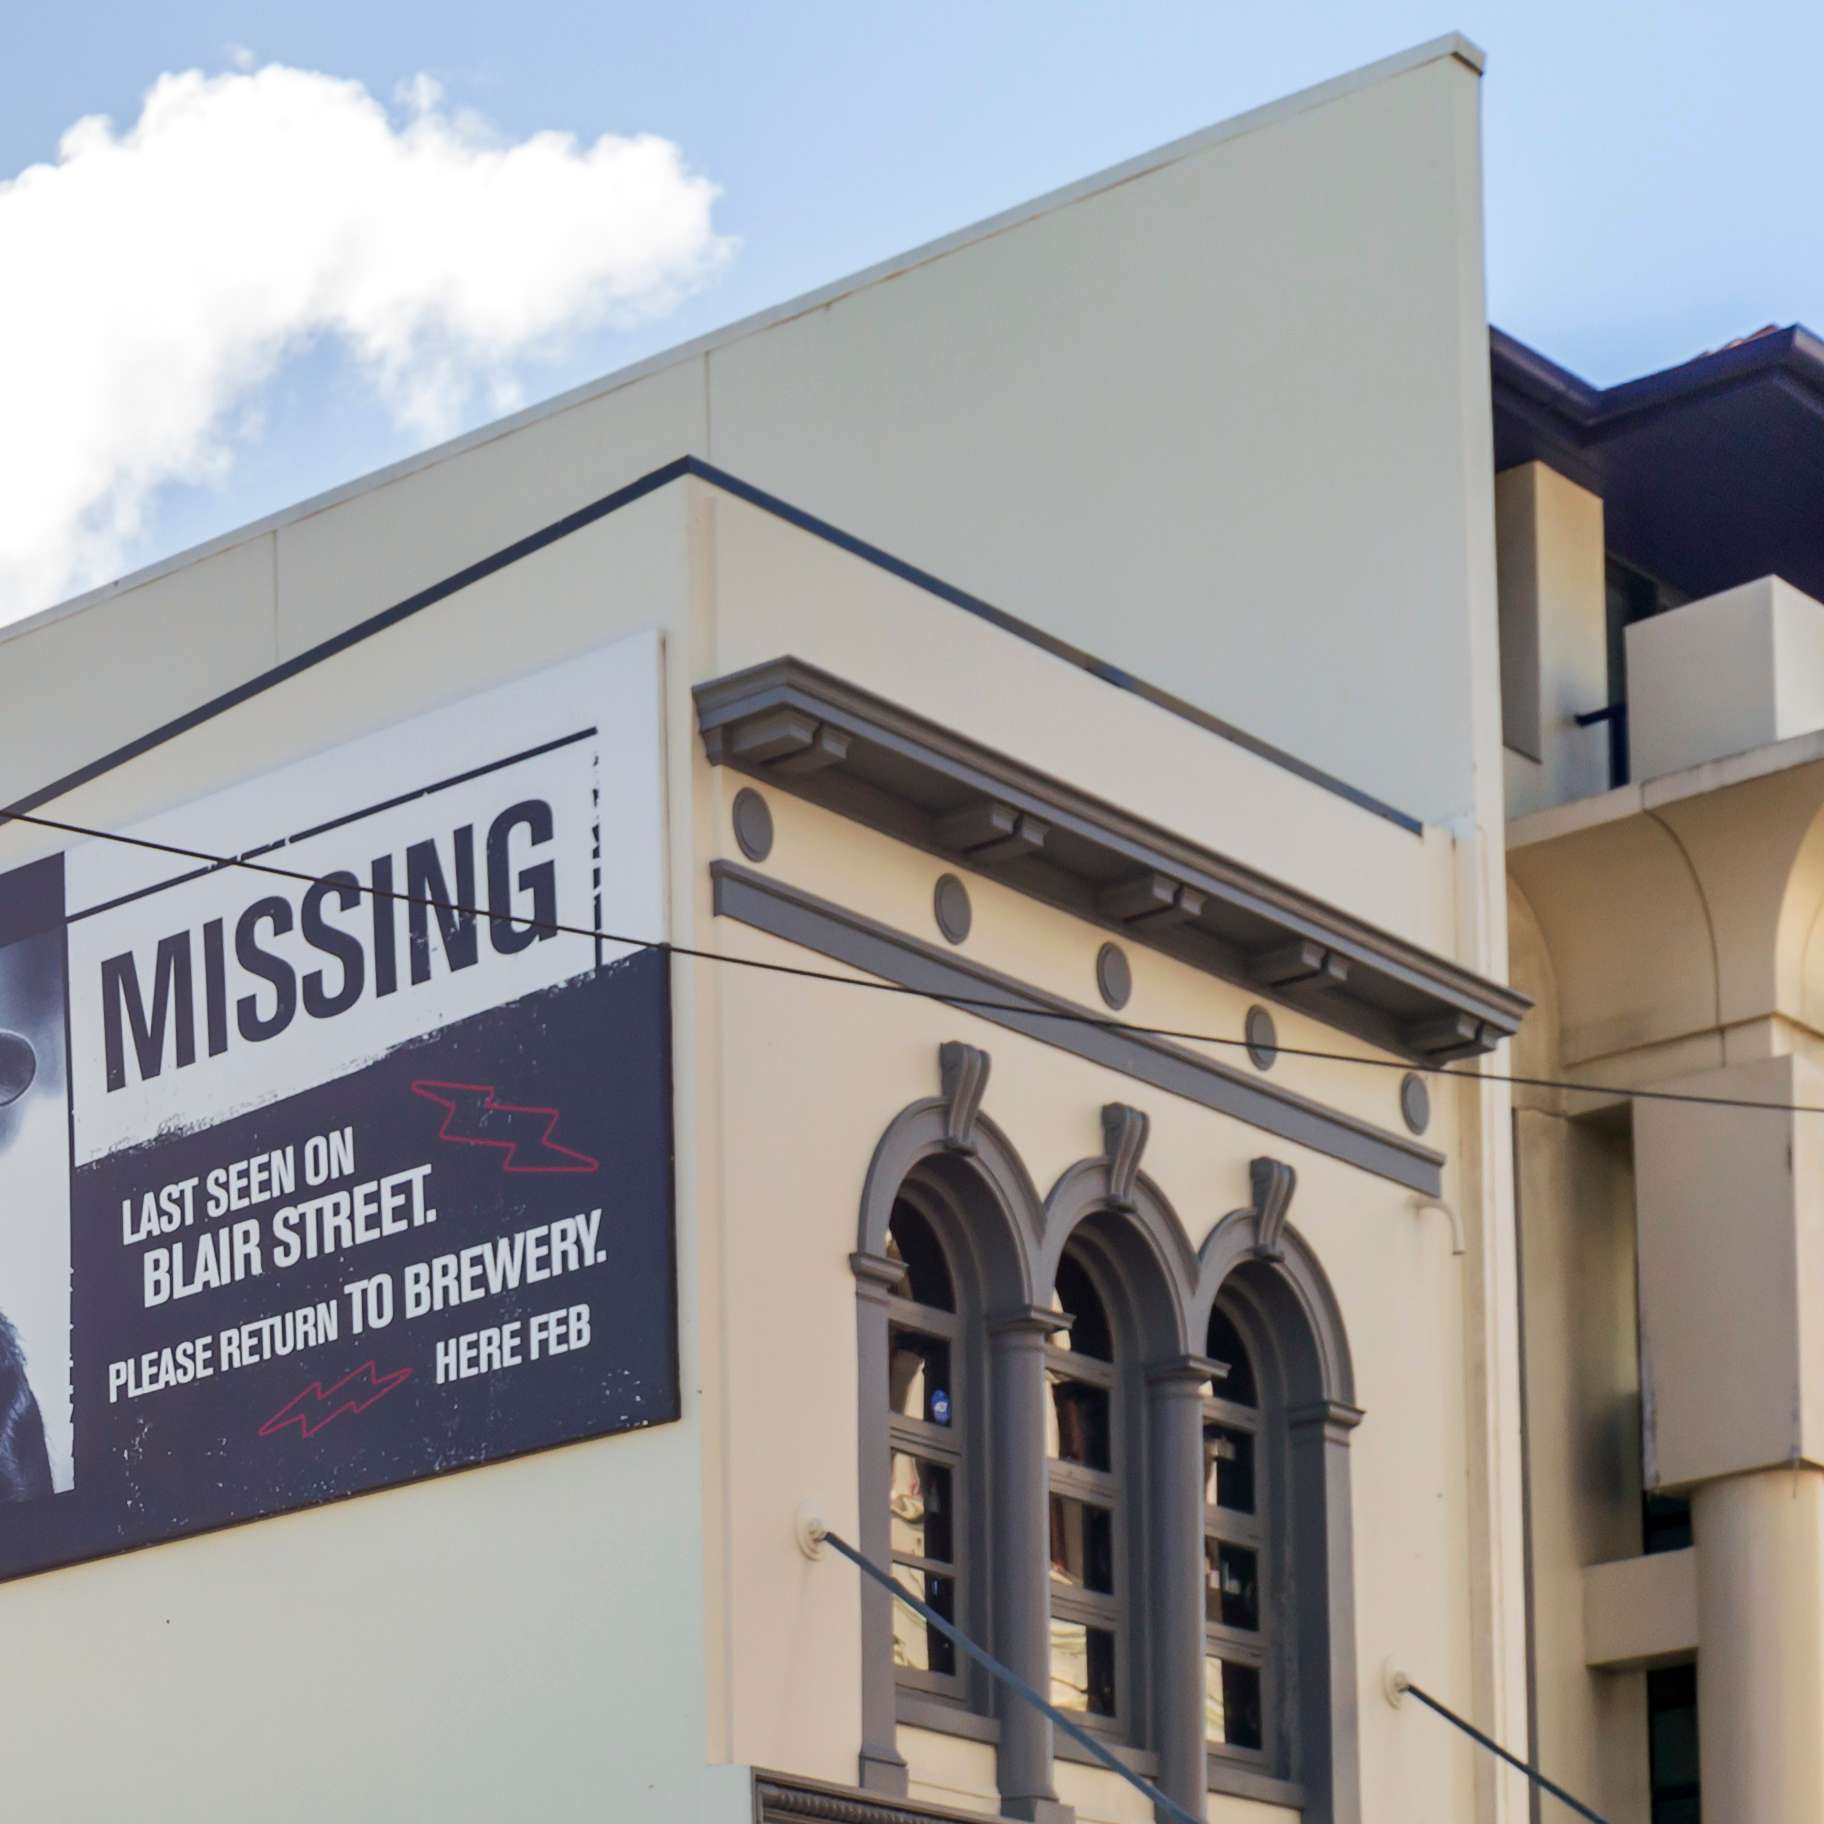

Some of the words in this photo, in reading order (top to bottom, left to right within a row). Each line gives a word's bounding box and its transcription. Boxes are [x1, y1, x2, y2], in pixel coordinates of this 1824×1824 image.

[101, 799, 557, 1093] MISSING
[122, 1177, 200, 1246] LAST
[206, 1145, 294, 1218] SEEN
[304, 1126, 355, 1186] ON
[143, 1218, 262, 1308] BLAIR
[272, 1164, 437, 1268] STREET.
[108, 1336, 213, 1403] PLEASE
[219, 1299, 338, 1371] RETURN
[343, 1273, 393, 1336] TO
[404, 1208, 607, 1319] BREWERY.
[435, 1321, 522, 1384] HERE
[530, 1303, 591, 1361] FEB
